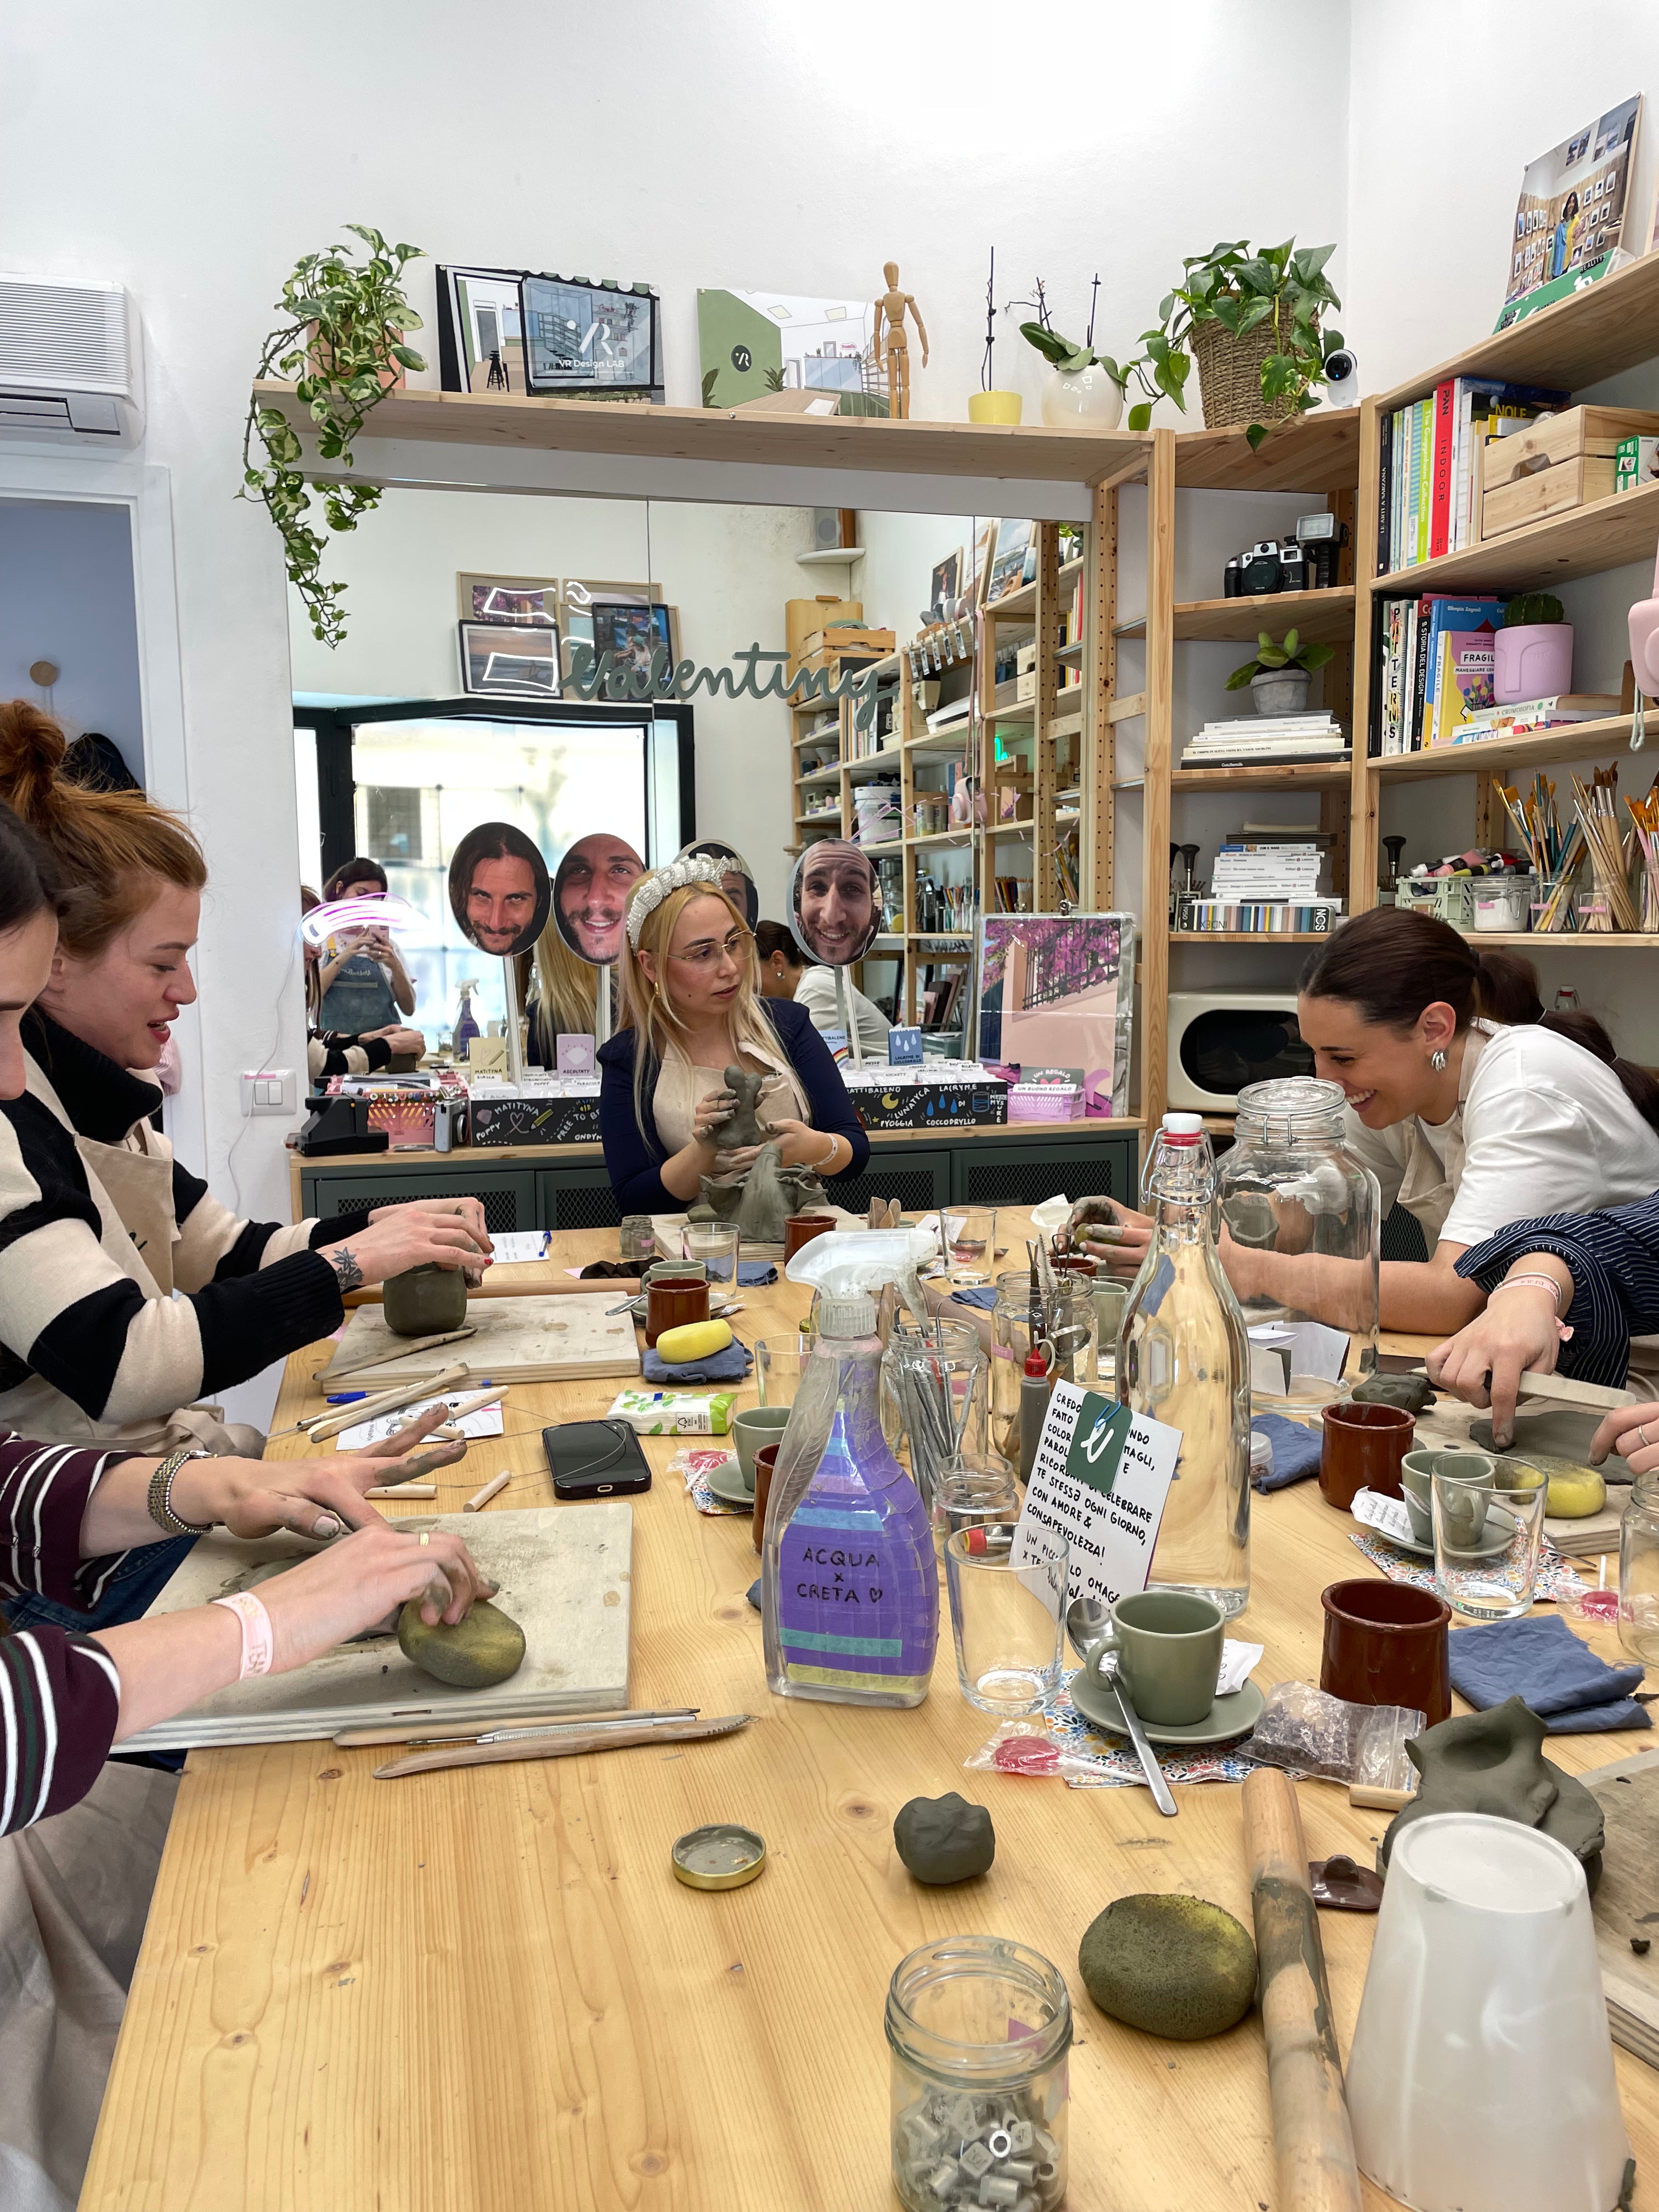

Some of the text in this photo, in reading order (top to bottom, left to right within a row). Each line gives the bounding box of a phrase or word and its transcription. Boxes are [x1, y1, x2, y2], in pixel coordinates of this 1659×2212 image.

[1579, 255, 1605, 274] REALITY
[574, 360, 603, 369] Design
[1438, 439, 1447, 501] INDOOR
[1464, 653, 1494, 662] FRAGIL
[1502, 704, 1534, 715] CROMOSOFIA
[1201, 921, 1227, 929] INDEX
[1315, 908, 1326, 931] NCS
[1045, 1069, 1071, 1079] REGALO
[939, 1084, 978, 1092] LACRYME
[494, 1101, 539, 1117] MATITYNA
[894, 1087, 930, 1119] LUNATYCA
[476, 1122, 500, 1141] POPPY
[557, 1120, 574, 1141] FREE
[573, 1113, 586, 1121] TO
[881, 1119, 913, 1128] PYOGGIA
[926, 1118, 977, 1126] COCCODRYLLO
[574, 1133, 602, 1141] ONDYN
[1057, 1392, 1082, 1413] CREDO
[1052, 1408, 1074, 1424] FATTO
[1048, 1423, 1150, 1445] COLOR NDO
[1044, 1436, 1069, 1458] PAROL
[1032, 1486, 1092, 1529] CON AMORE &
[1037, 1467, 1047, 1479] TE
[1085, 1498, 1107, 1519] OGNI
[1110, 1511, 1146, 1546] GIORNO,
[1026, 1503, 1105, 1566] CONSAPEVOLEZZA!
[1026, 1529, 1038, 1546] UN
[802, 1548, 880, 1568] ACQUA
[797, 1583, 860, 1604] CRETA
